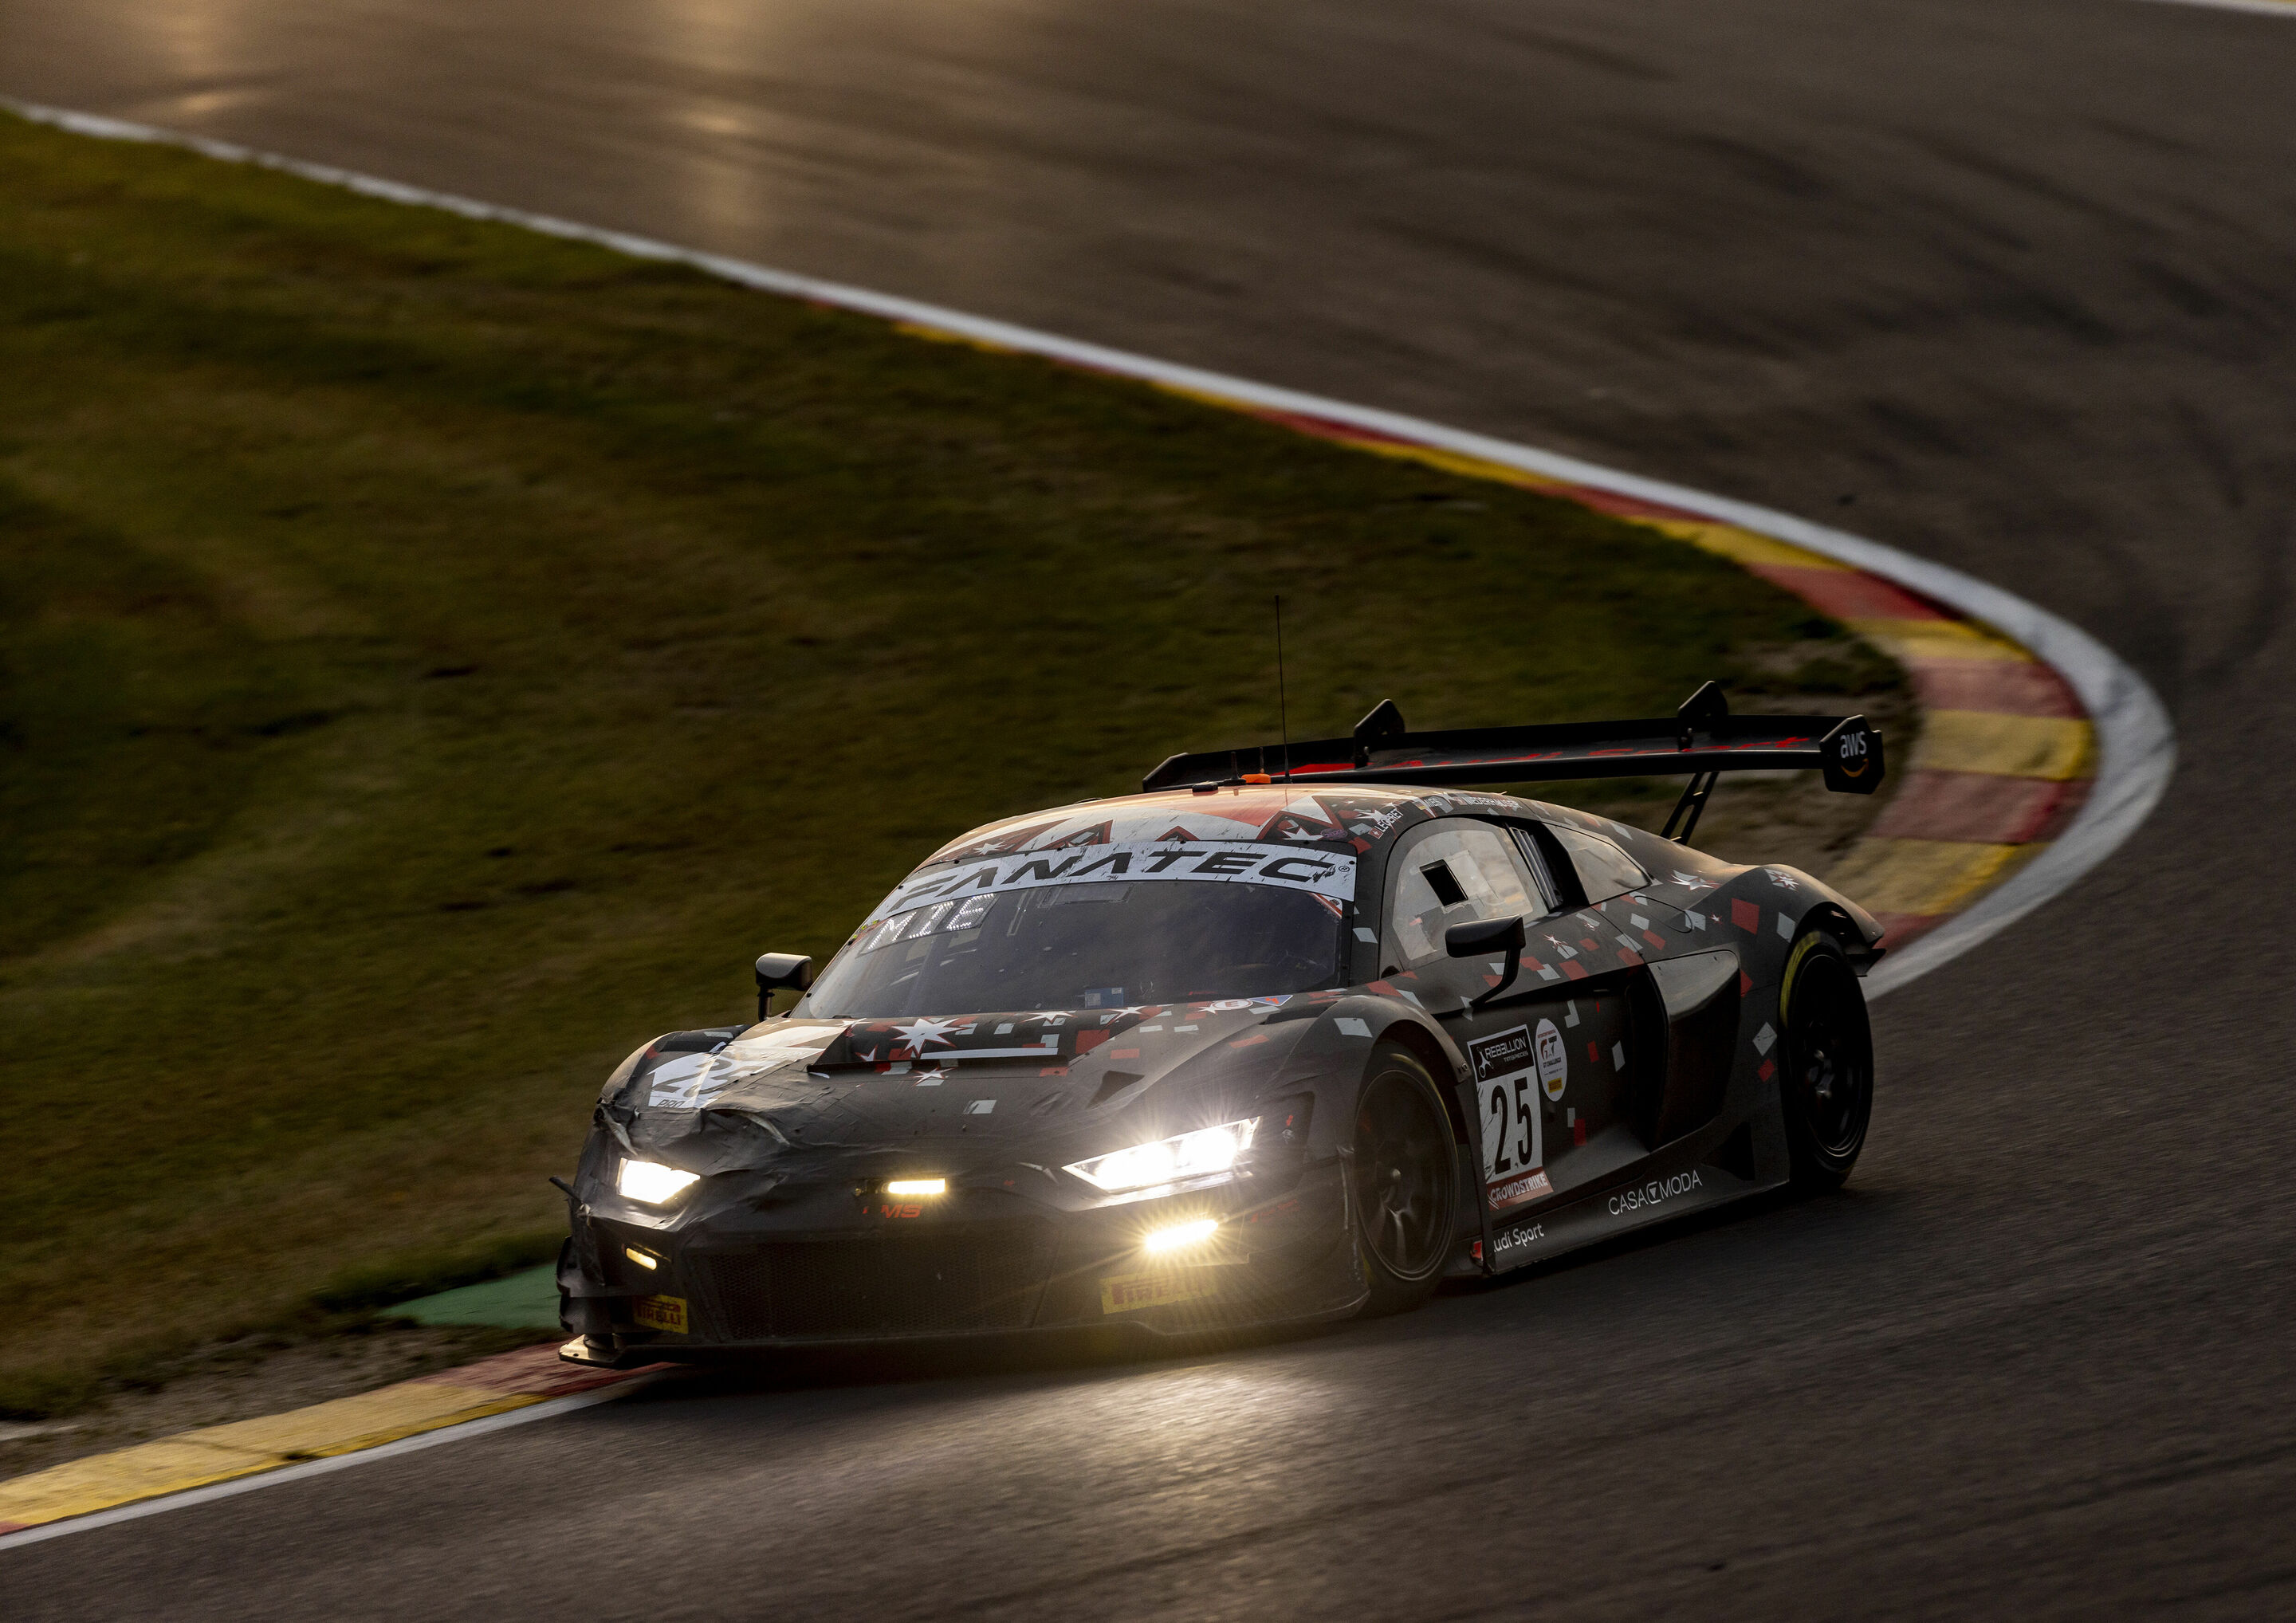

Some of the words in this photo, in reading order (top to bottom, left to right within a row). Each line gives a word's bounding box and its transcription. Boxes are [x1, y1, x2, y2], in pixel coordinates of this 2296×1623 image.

[1840, 731, 1867, 758] aws
[887, 851, 1336, 914] FANATEC
[1484, 1036, 1527, 1059] REBELLION
[1491, 1076, 1533, 1175] 25
[1490, 1173, 1549, 1202] CROWDSTRIKE
[1493, 1231, 1513, 1252] udi
[1514, 1223, 1545, 1248] Sport
